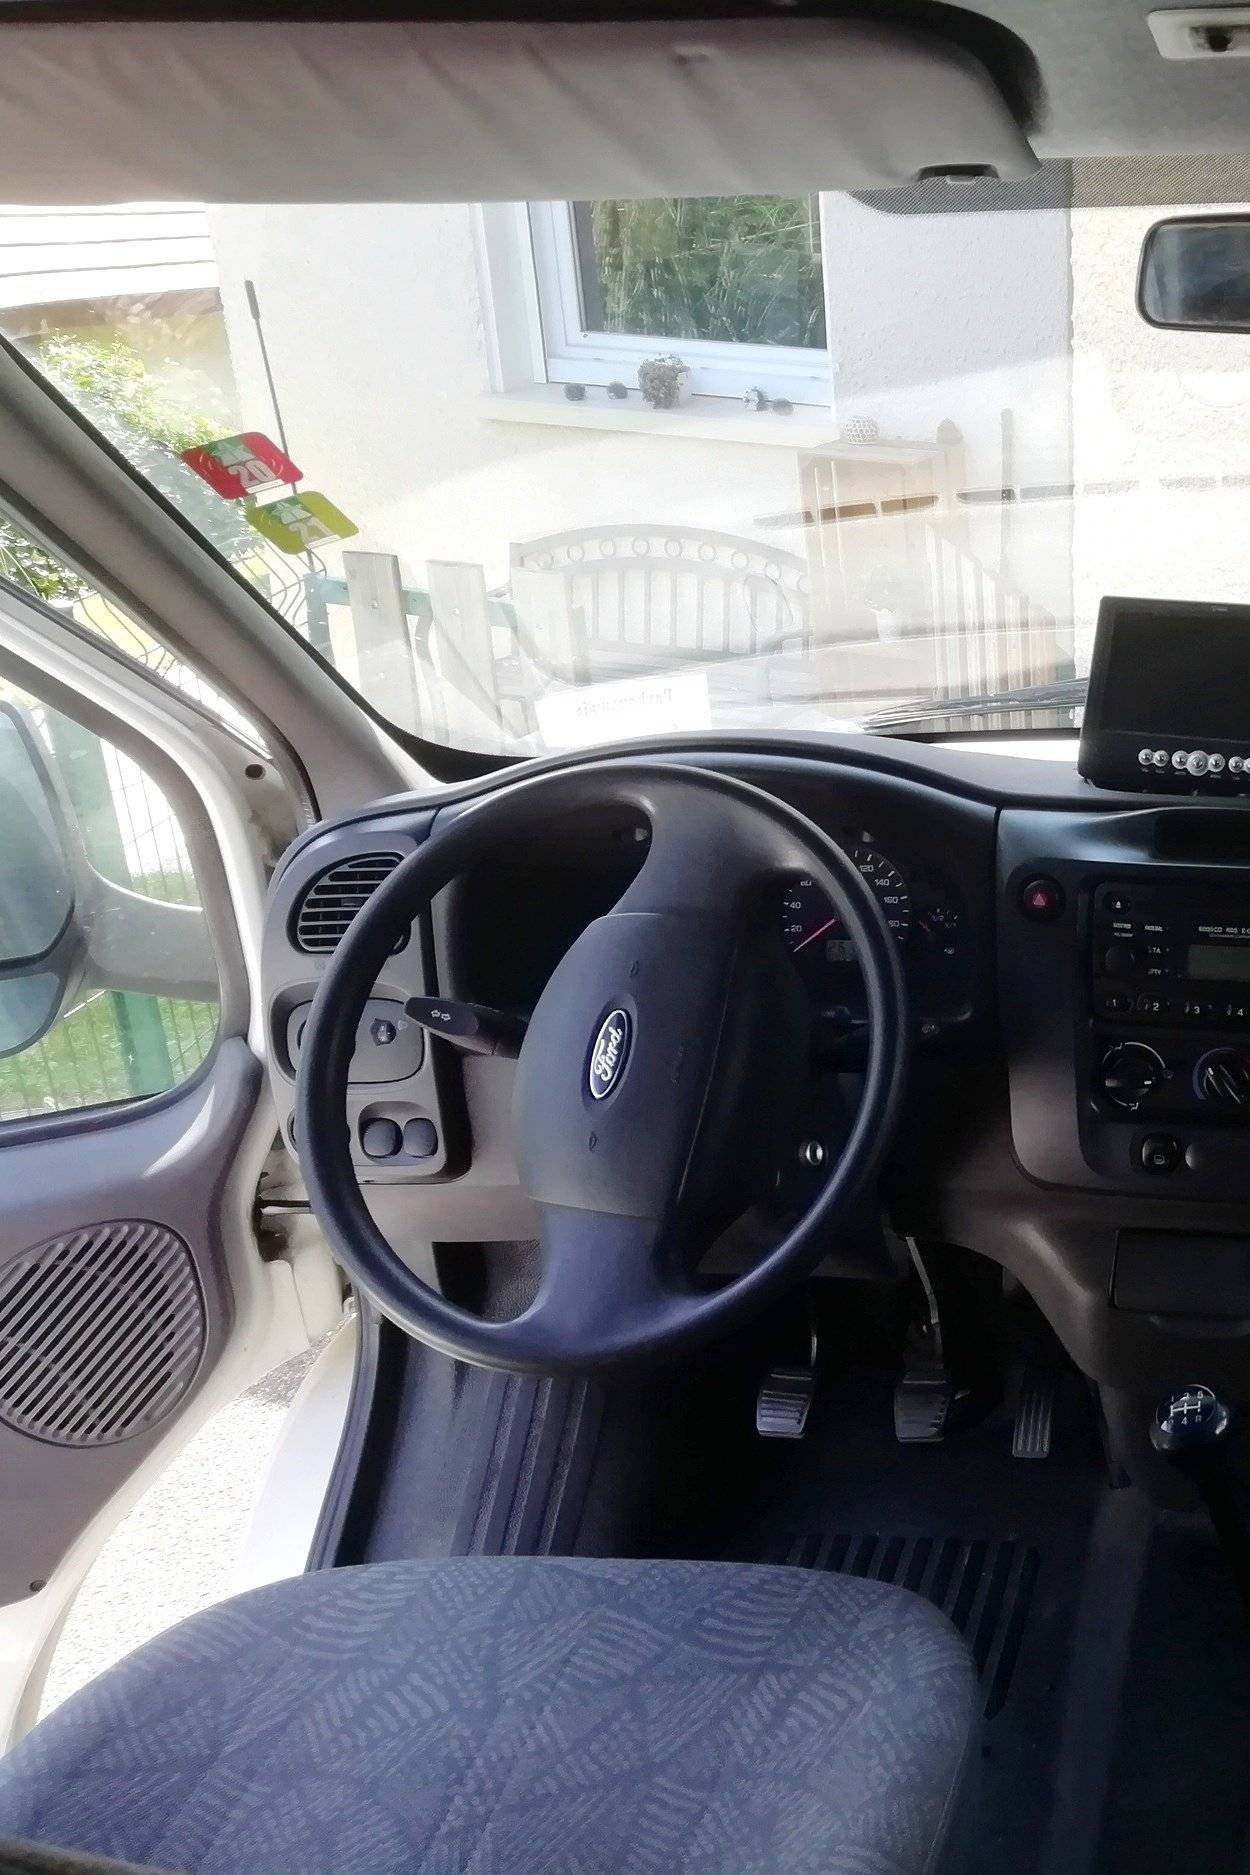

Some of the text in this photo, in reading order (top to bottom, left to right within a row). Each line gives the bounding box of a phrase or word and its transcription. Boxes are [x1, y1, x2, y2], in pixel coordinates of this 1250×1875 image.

[228, 460, 277, 488] 20
[874, 878, 890, 886] 140
[790, 901, 801, 909] 40
[1193, 1006, 1200, 1014] 3
[1237, 1008, 1244, 1016] 4
[594, 1027, 624, 1081] Ford
